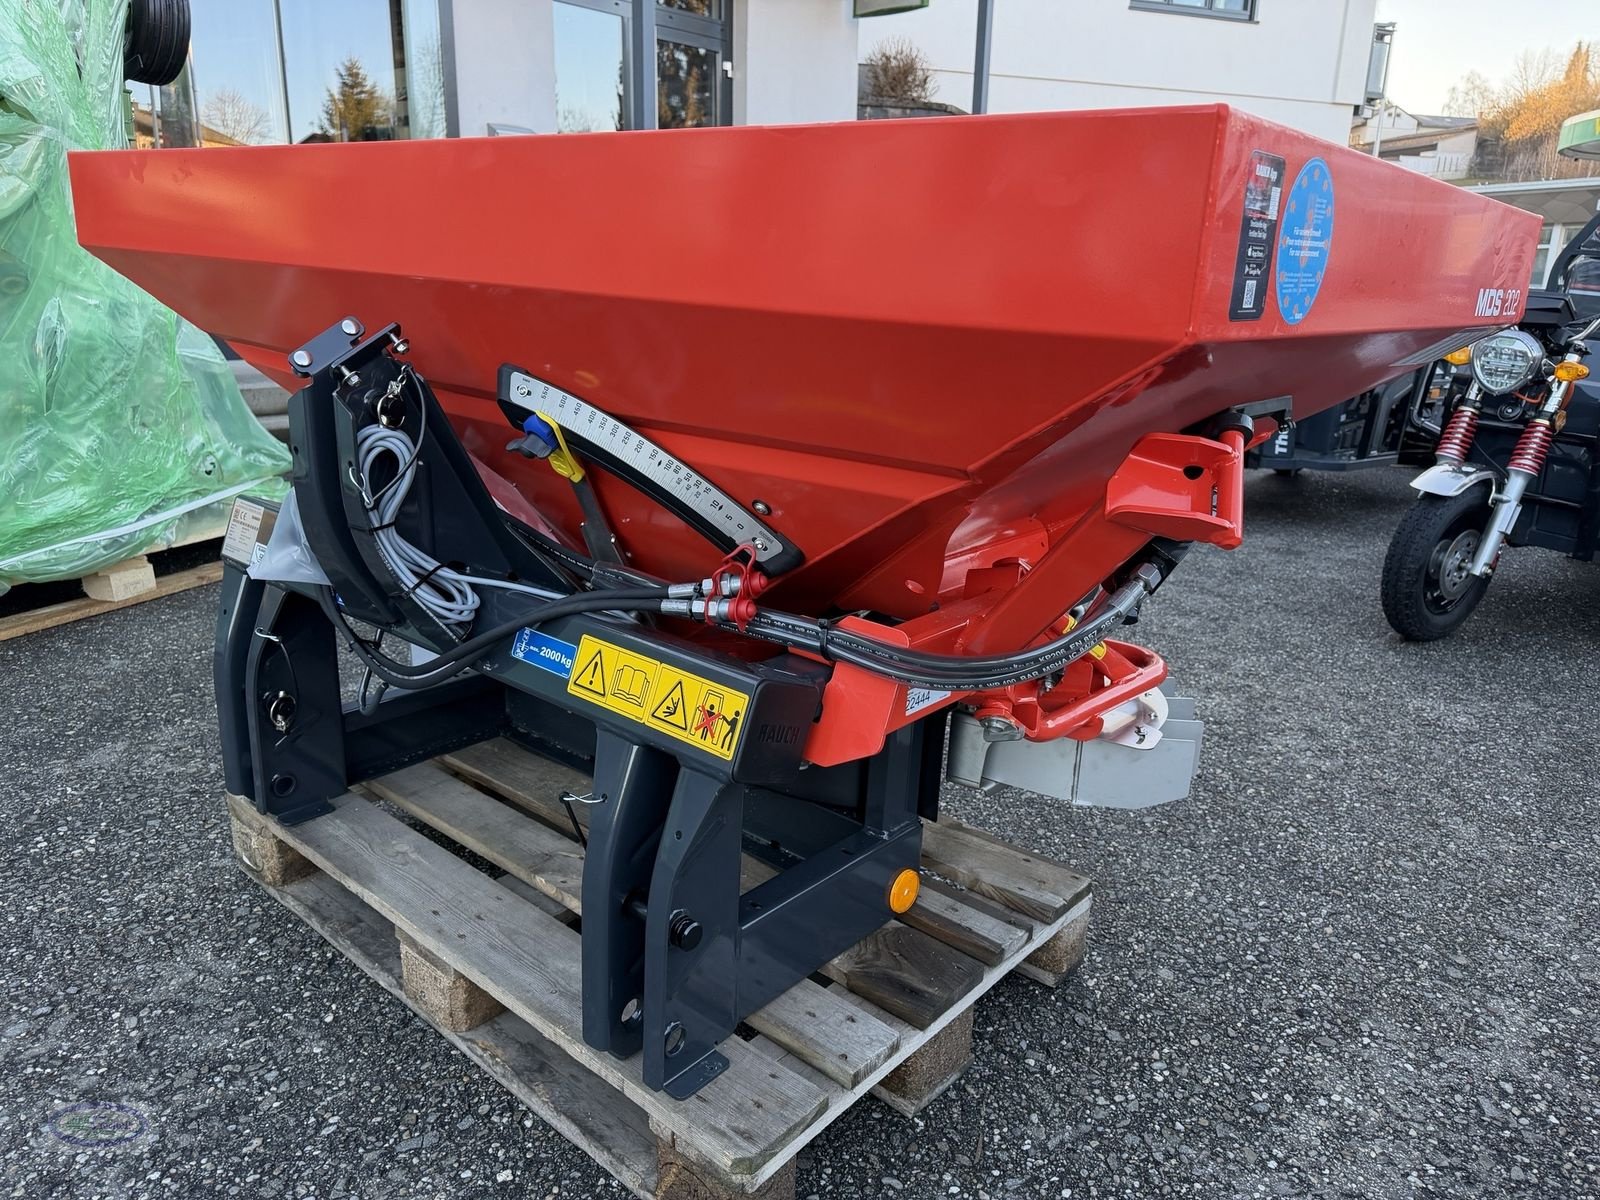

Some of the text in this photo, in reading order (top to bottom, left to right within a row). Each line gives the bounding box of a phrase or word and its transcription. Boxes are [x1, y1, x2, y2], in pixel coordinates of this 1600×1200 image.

[1474, 288, 1521, 317] MDS 202
[541, 386, 550, 400] 550
[559, 394, 568, 408] 500
[573, 402, 582, 416] 450
[588, 410, 597, 424] 400
[598, 416, 608, 430] 350
[610, 424, 620, 438] 300
[622, 431, 632, 444] 250
[634, 440, 644, 454] 200
[648, 448, 659, 460] 150
[664, 460, 674, 472] 100
[672, 464, 682, 474] 80
[676, 477, 682, 485] 60
[684, 472, 692, 482] 50
[693, 479, 702, 489] 30
[694, 491, 702, 499] 20
[703, 486, 712, 495] 15
[710, 500, 720, 509] 10
[1069, 641, 1084, 650] EN
[1084, 630, 1098, 644] 857
[540, 646, 562, 662] 2000
[561, 654, 572, 668] kg
[1020, 670, 1039, 682] BAR
[1042, 658, 1068, 672] MSHA
[760, 724, 800, 745] RAUCH
